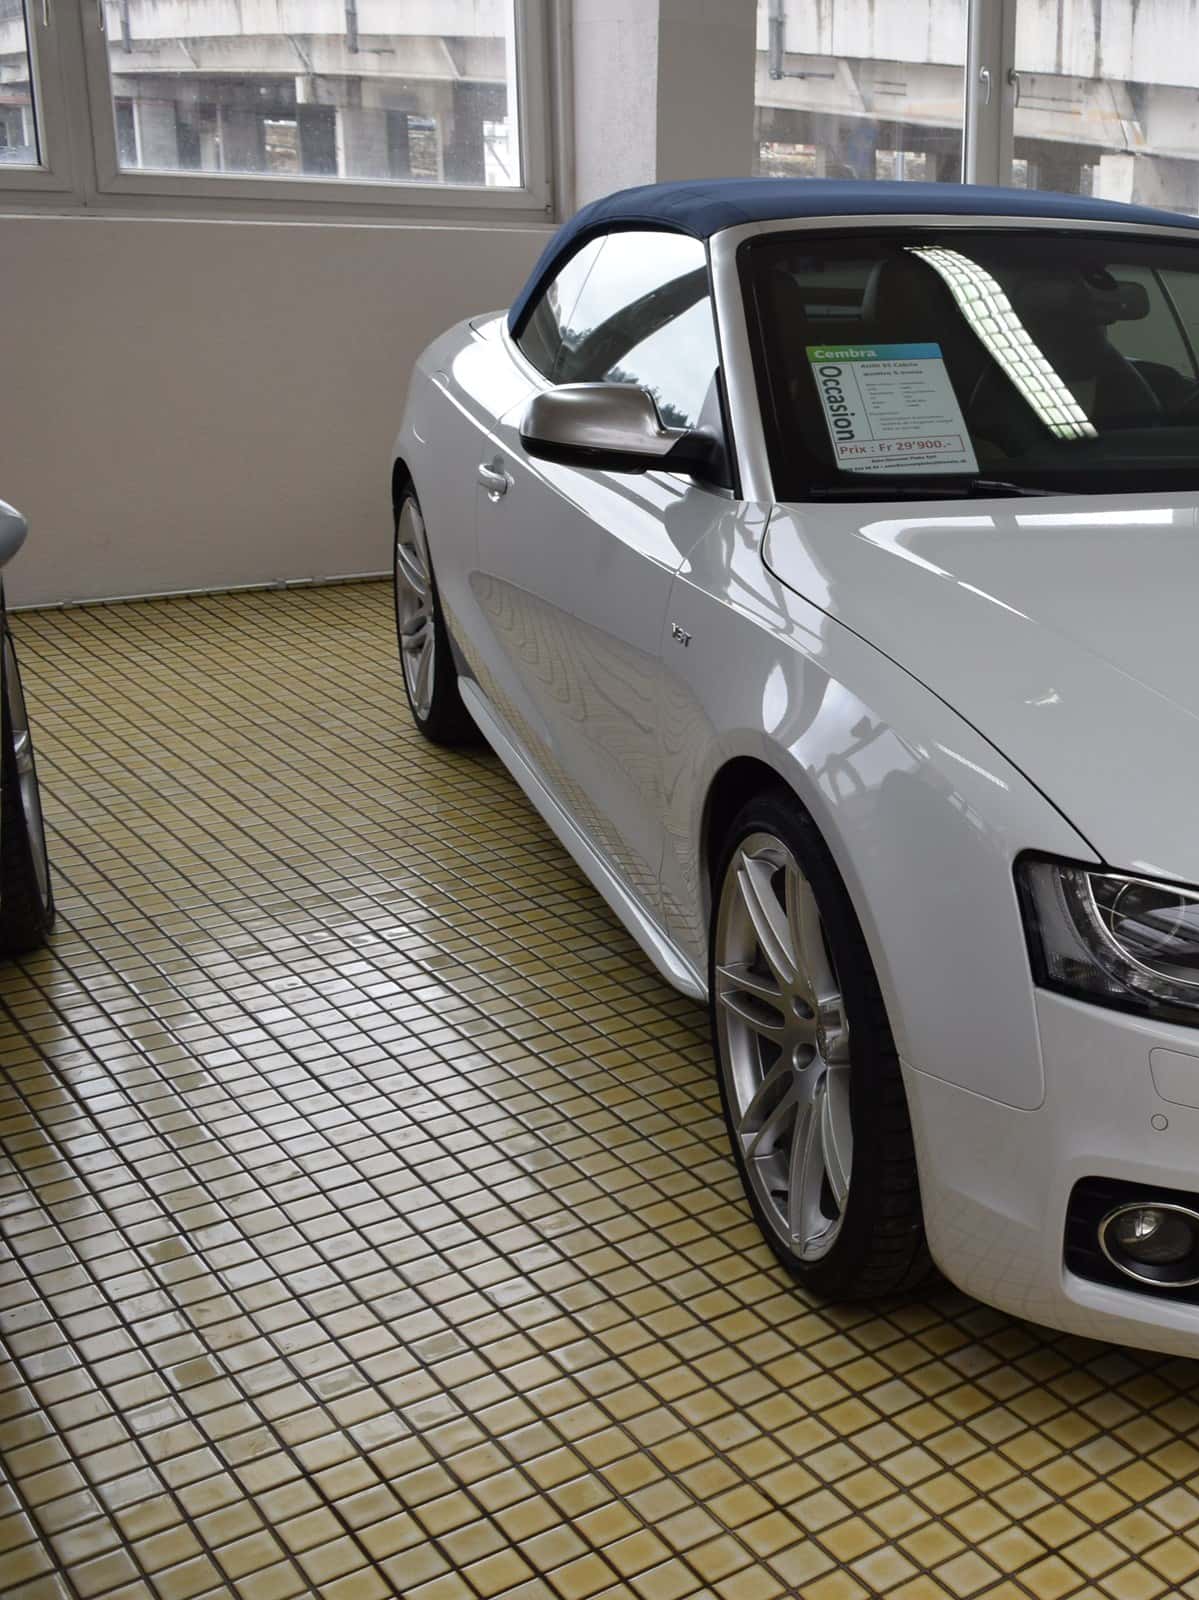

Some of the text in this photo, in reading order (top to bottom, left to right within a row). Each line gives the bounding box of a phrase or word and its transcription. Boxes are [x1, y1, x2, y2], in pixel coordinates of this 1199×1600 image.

[814, 349, 877, 359] Cembra
[819, 366, 855, 441] Occasion
[840, 446, 866, 455] Prix
[879, 443, 892, 452] Fr
[895, 440, 952, 451] 29'900.-
